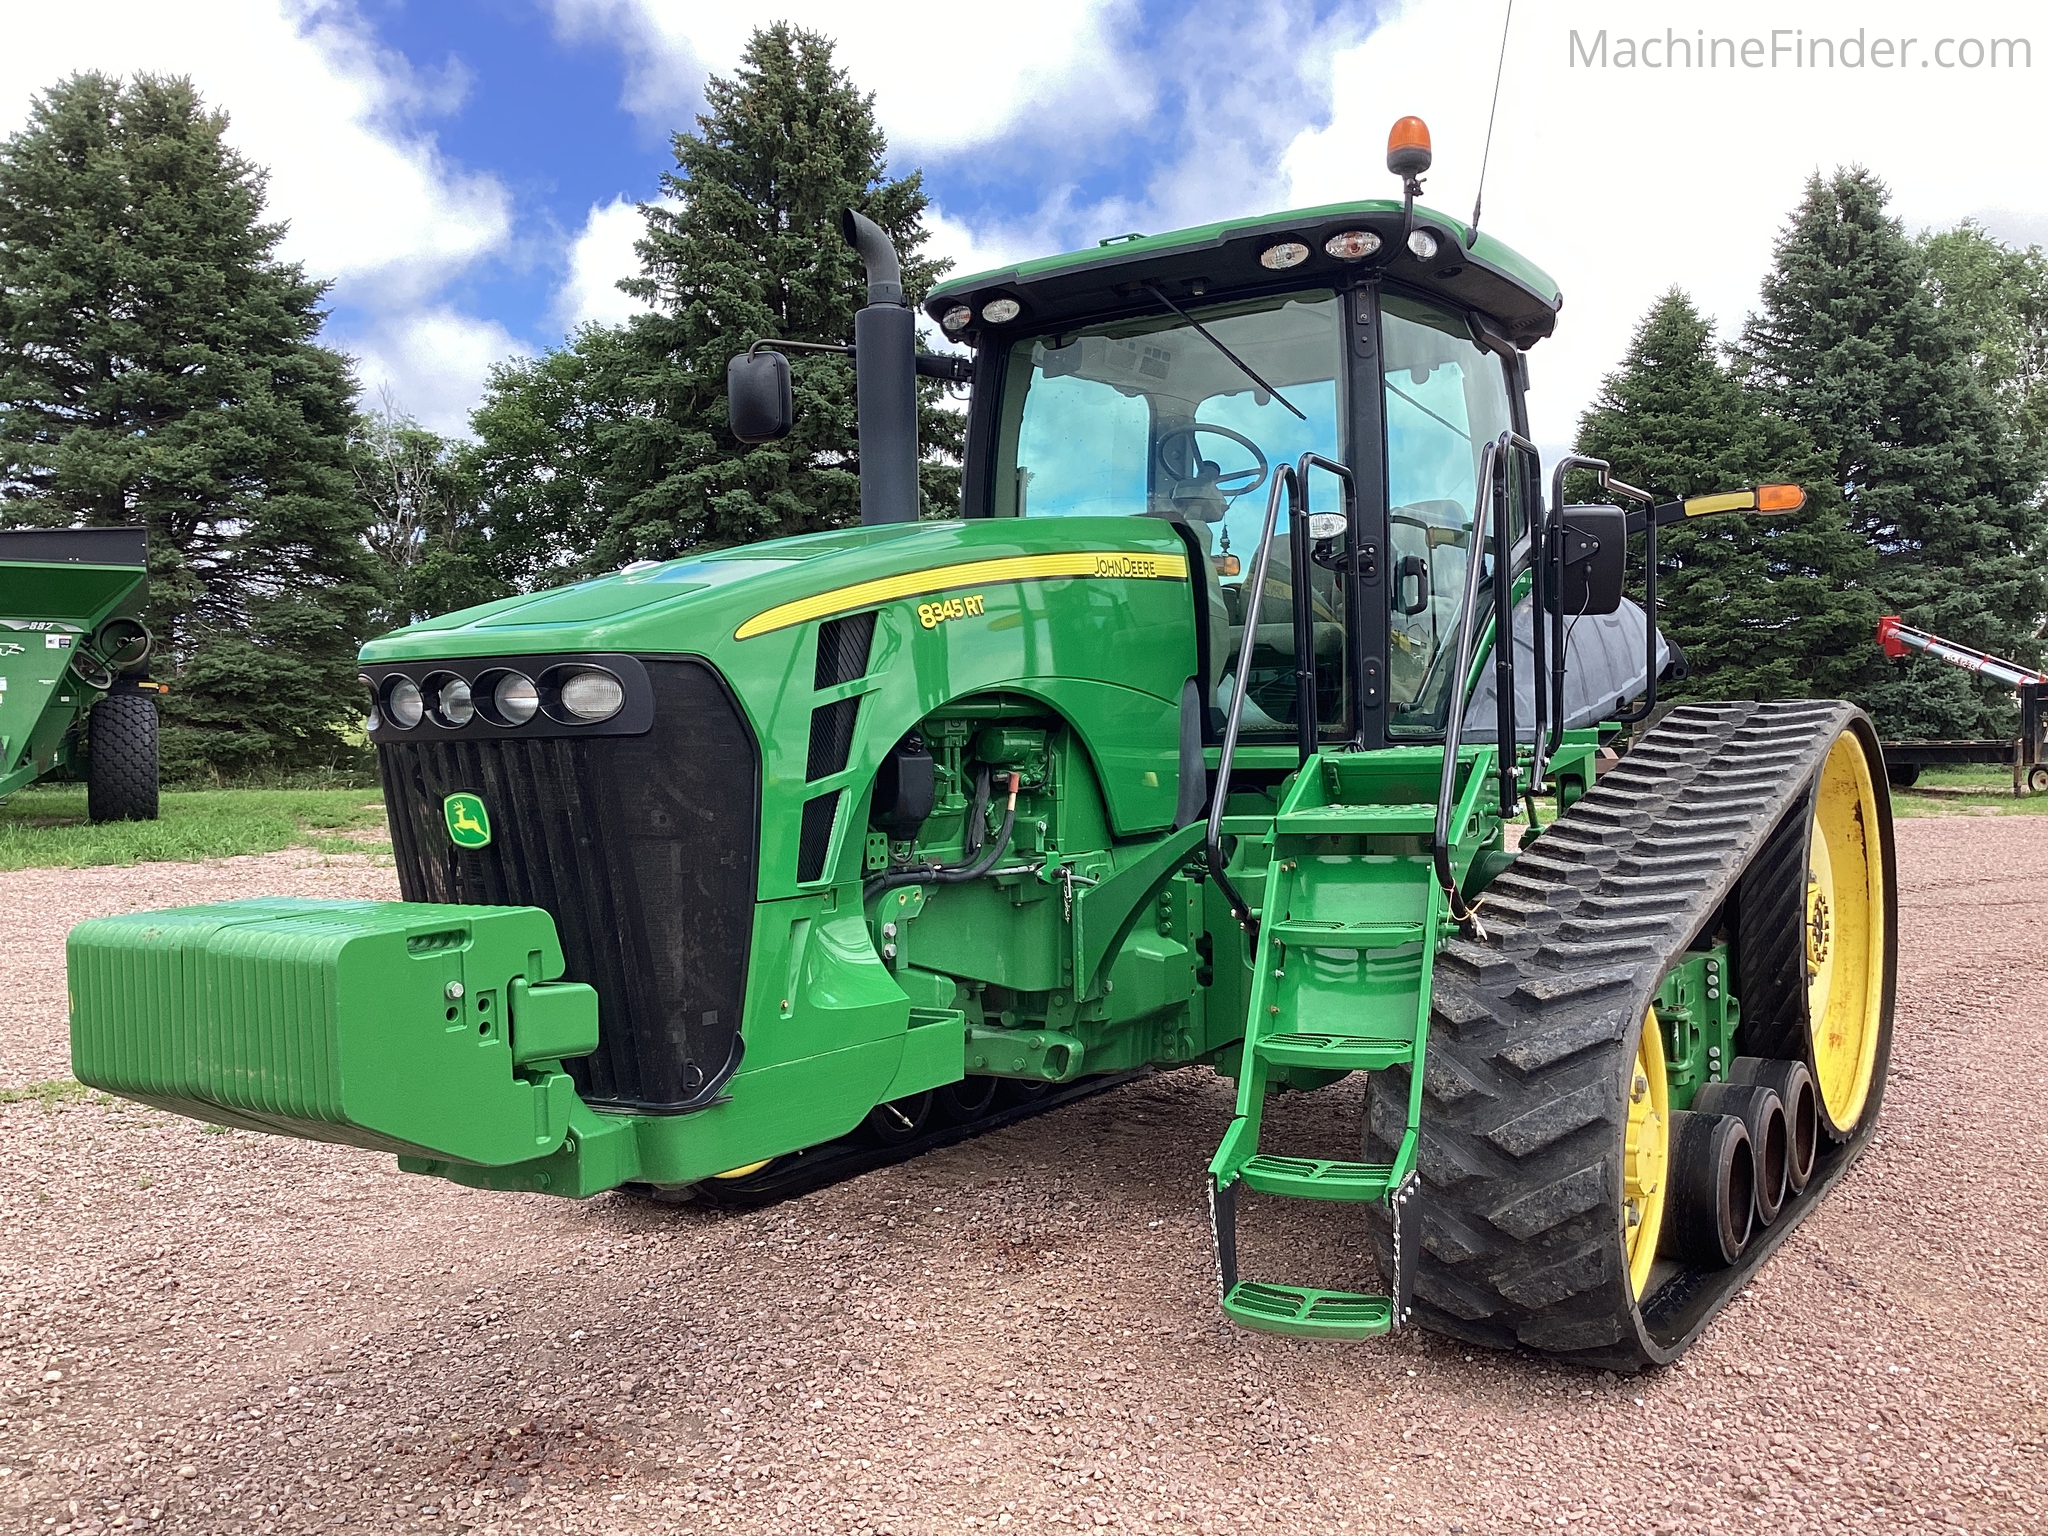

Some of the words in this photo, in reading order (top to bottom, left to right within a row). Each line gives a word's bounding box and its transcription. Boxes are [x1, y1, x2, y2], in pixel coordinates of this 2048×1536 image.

[1094, 556, 1122, 576] JOHN
[1122, 557, 1157, 577] DEERE
[917, 598, 964, 630] 8345
[963, 594, 985, 618] RT
[29, 621, 54, 631] 882
